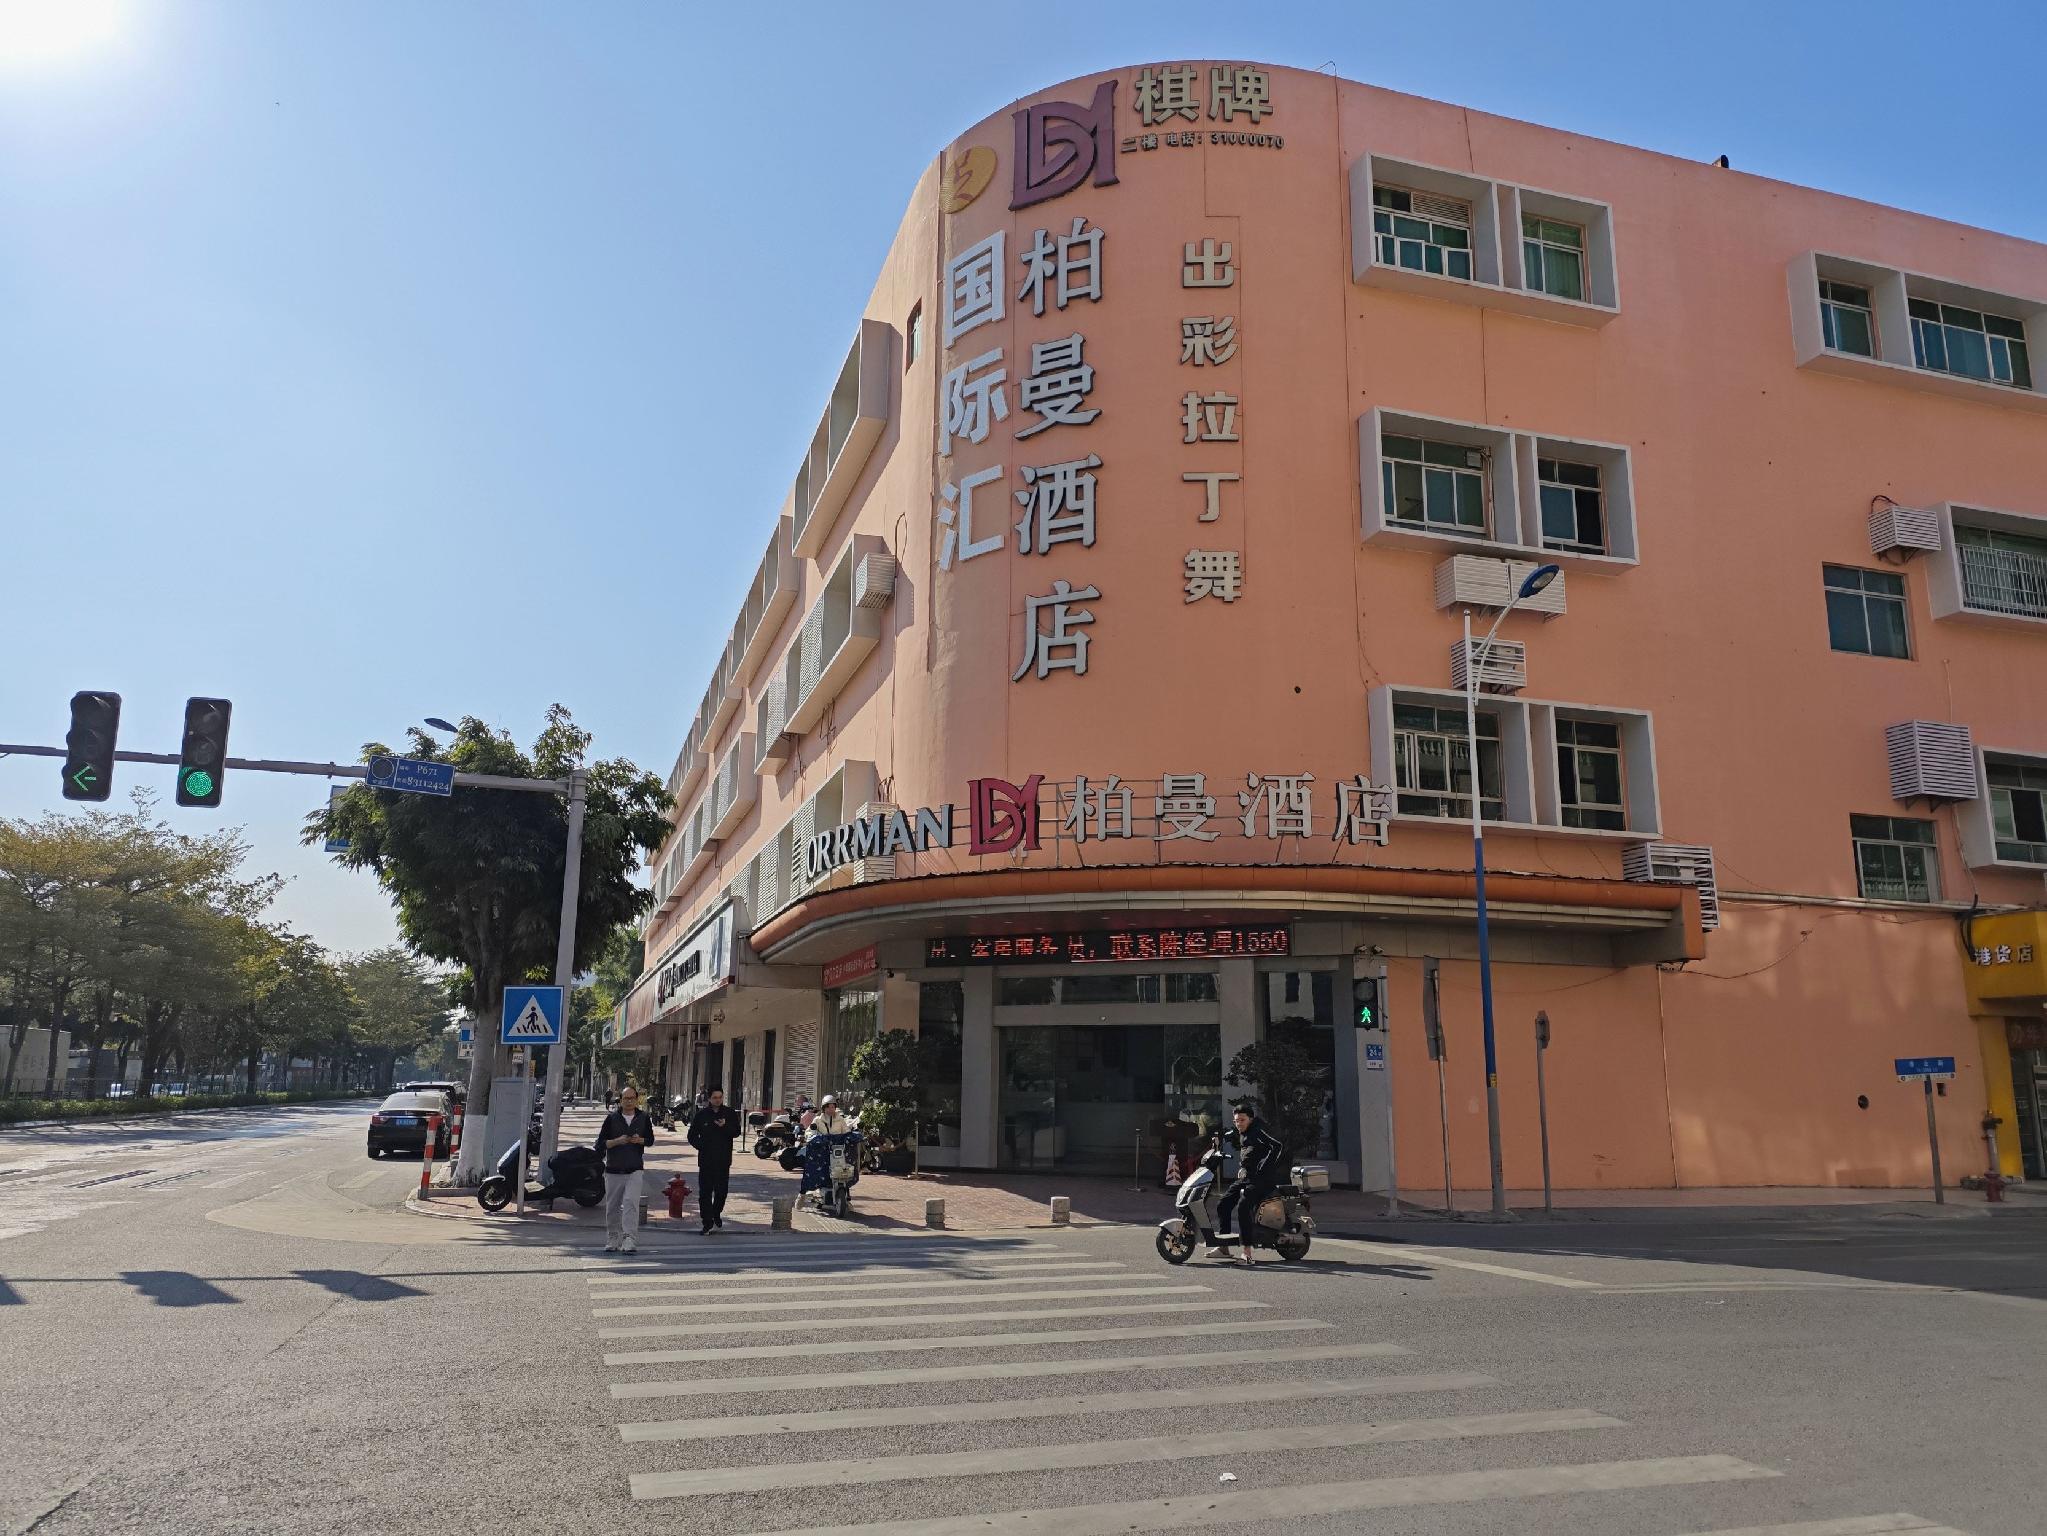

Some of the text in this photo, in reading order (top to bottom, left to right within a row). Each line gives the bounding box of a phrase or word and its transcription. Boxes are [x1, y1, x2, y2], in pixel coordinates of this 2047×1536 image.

[1120, 133, 1160, 152] 二楼
[1133, 64, 1274, 126] 棋牌
[938, 229, 1010, 572] 国际汇
[1012, 217, 1107, 683] 柏曼酒店
[1180, 237, 1243, 605] 出彩拉丁舞
[1063, 771, 1394, 847] 柏曼酒店
